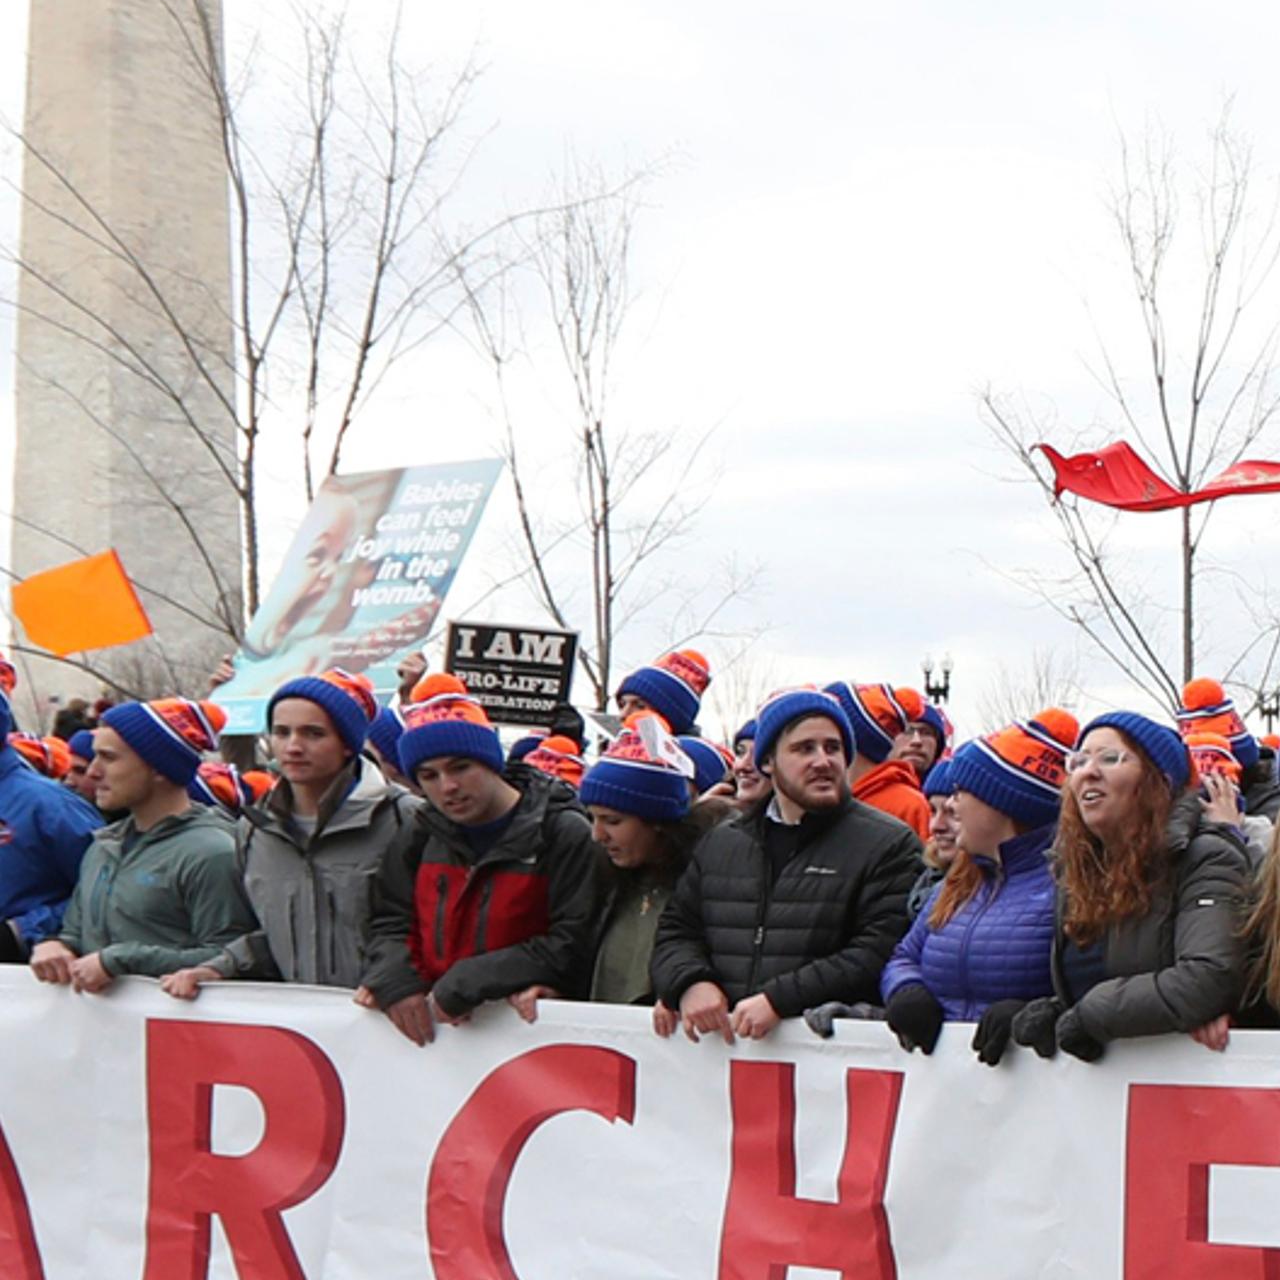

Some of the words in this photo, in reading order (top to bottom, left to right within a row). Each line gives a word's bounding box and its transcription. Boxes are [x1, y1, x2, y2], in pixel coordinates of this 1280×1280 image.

[399, 480, 484, 505] Babies
[375, 512, 423, 533] can
[422, 503, 475, 528] feel
[346, 535, 392, 563] joy
[395, 528, 461, 555] while
[375, 556, 403, 581] in
[404, 556, 450, 579] the
[352, 579, 436, 607] womb.
[455, 629, 478, 658] I
[482, 630, 567, 666] AM
[453, 671, 561, 695] PRO-LIFE
